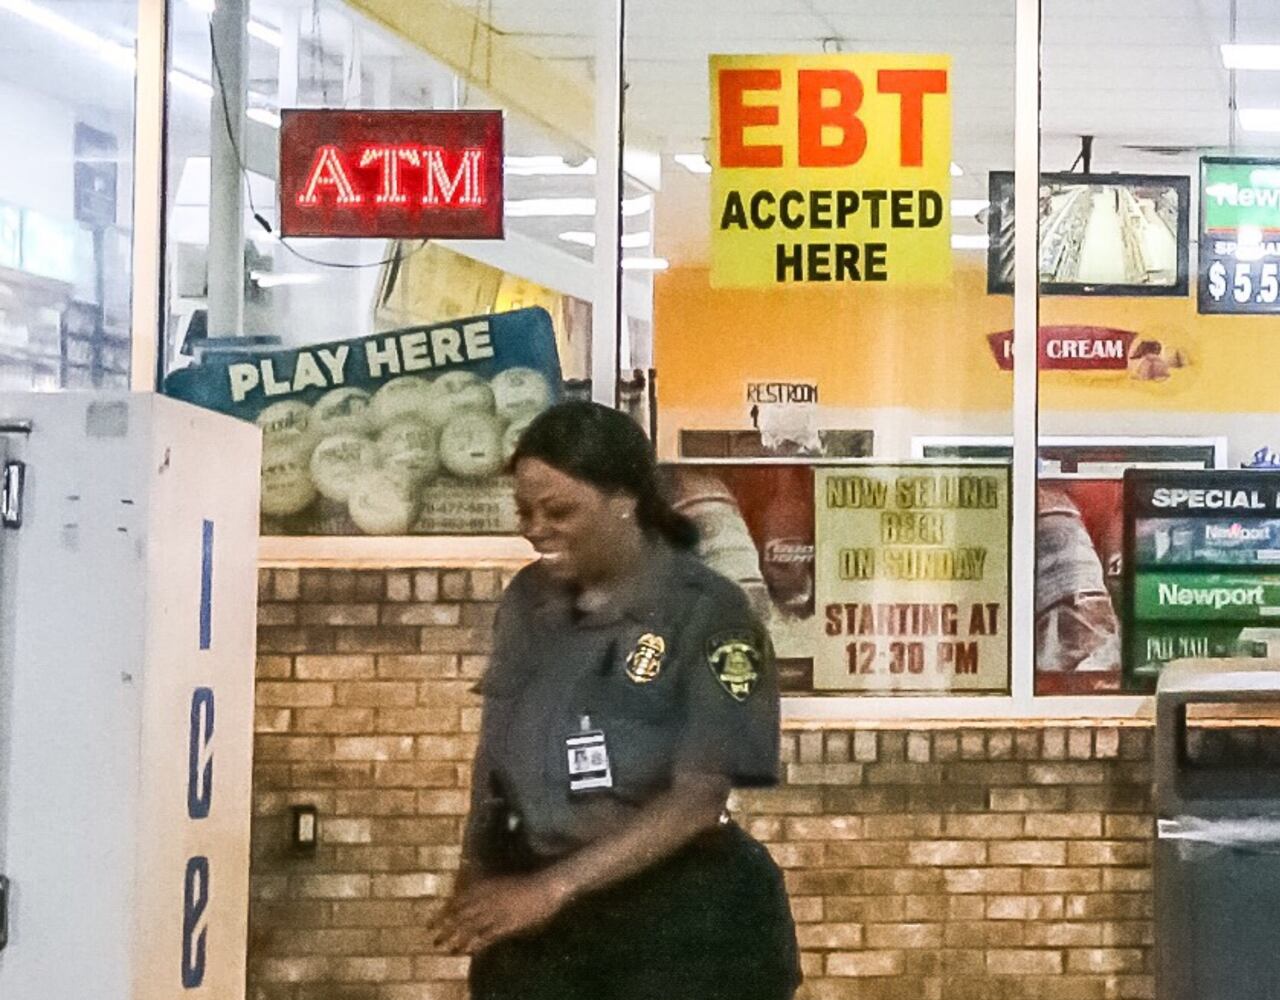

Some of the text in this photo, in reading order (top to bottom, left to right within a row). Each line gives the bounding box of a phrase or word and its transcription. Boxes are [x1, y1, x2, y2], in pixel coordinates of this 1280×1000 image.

[719, 69, 947, 168] EBT
[297, 146, 486, 205] ATM
[721, 190, 943, 230] ACCEPTED
[776, 243, 887, 282] HERE
[228, 320, 494, 402] PLAY HERE
[1047, 339, 1123, 359] CREAM
[825, 475, 998, 509] NOW SELLING
[1152, 488, 1266, 509] SPECIAL
[880, 512, 943, 545] BEER
[1205, 524, 1271, 541] Newport
[838, 547, 987, 580] ON SUNDAY
[1159, 583, 1264, 609] Newport
[825, 603, 1000, 636] STARTING AT
[846, 641, 979, 675] 12:30 PM
